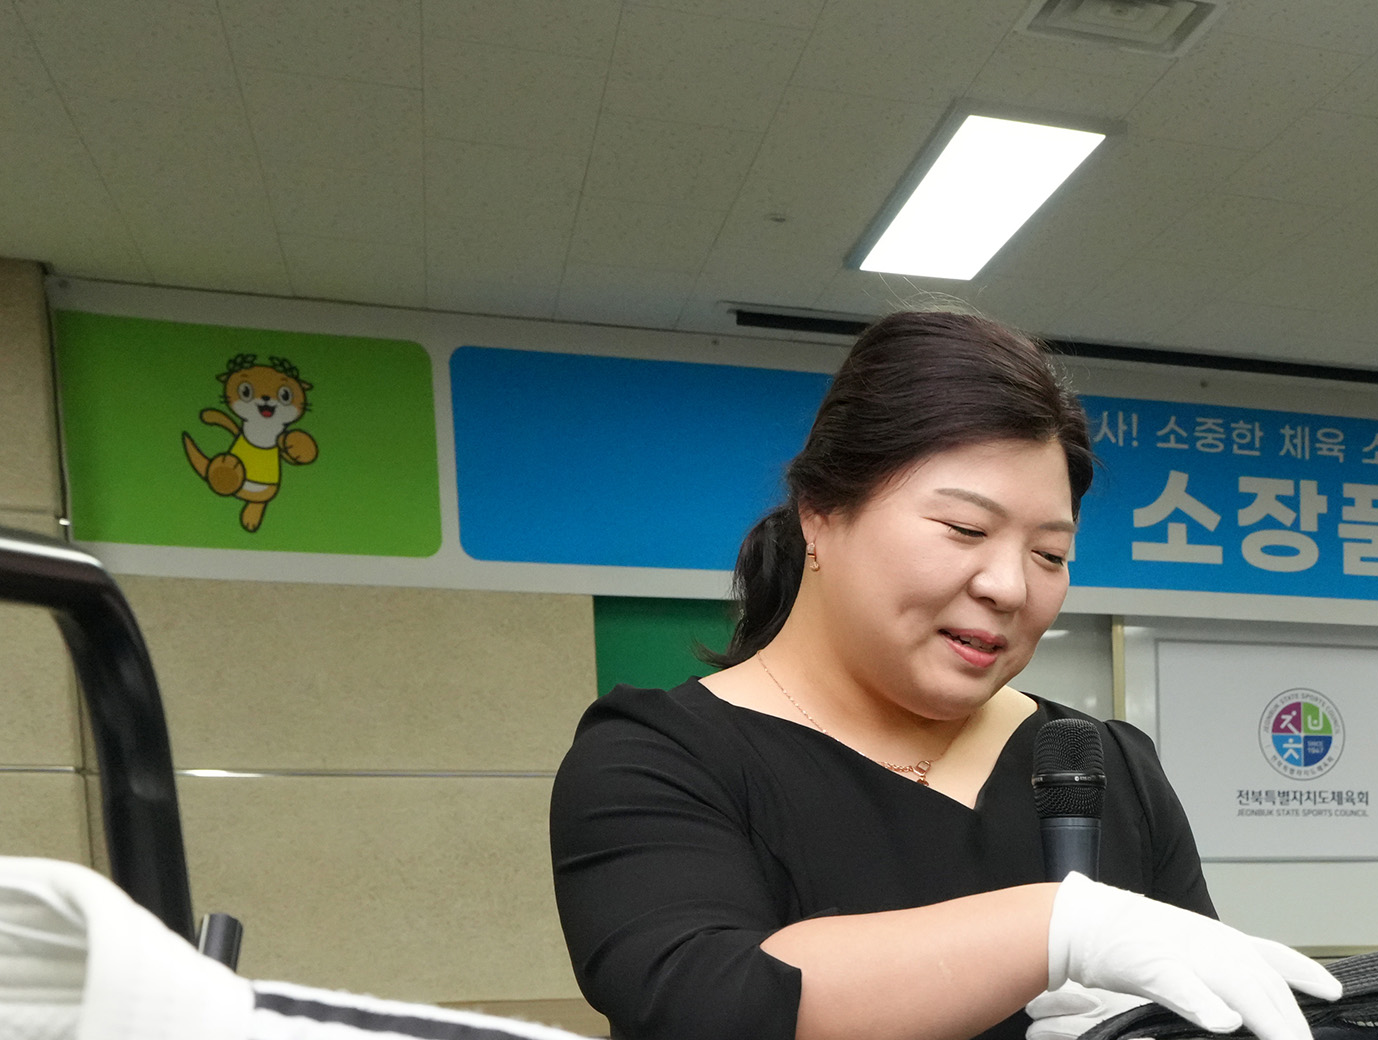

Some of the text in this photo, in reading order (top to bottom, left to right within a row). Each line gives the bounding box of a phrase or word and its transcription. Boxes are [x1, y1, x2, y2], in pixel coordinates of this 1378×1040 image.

[1093, 411, 1139, 447] 사!
[1156, 416, 1263, 457] 소중한
[1280, 424, 1345, 464] 체육
[1237, 789, 1369, 806] 전북특별자치도체육회
[1237, 808, 1369, 817] JEONBUK STATE SPORTS COUNCIL
